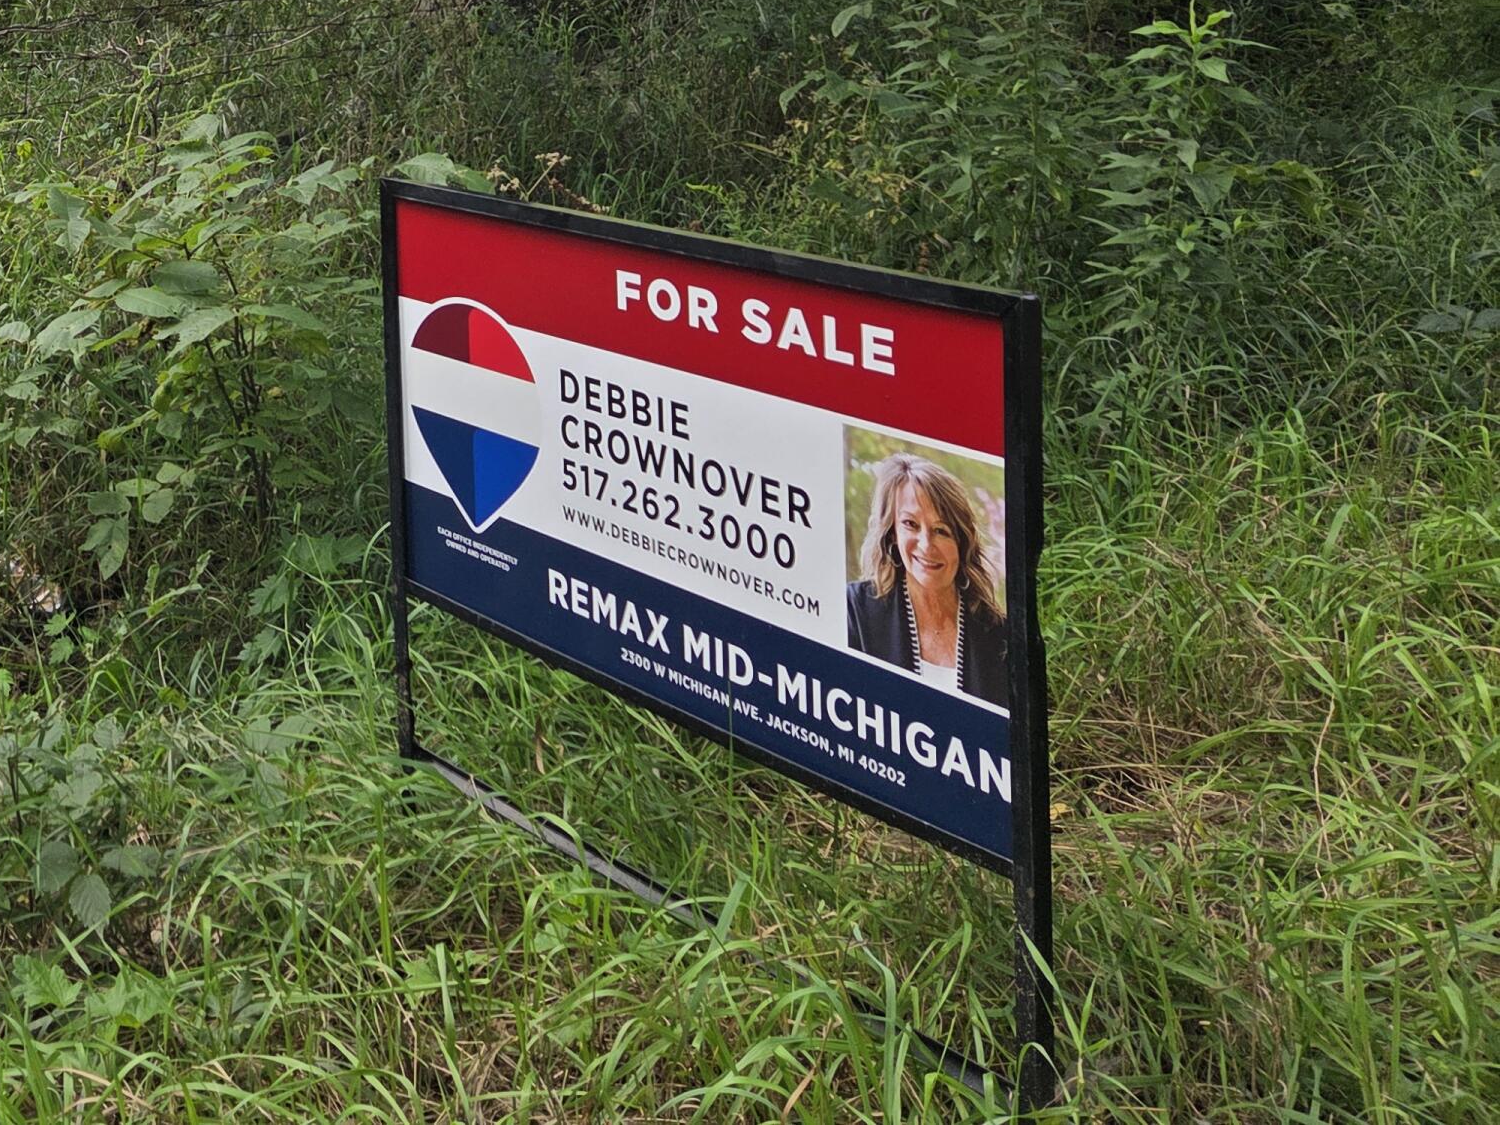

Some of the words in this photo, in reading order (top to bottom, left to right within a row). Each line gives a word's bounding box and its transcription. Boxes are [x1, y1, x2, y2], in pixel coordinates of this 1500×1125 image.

[616, 269, 719, 333] FOR
[741, 298, 895, 376] SALE
[560, 368, 690, 441] DEBBIE
[561, 415, 812, 529] CROWNOVER
[562, 458, 796, 569] 517.262.3000
[562, 504, 821, 617] WWW.DEBBIECROWNOVER.COM
[548, 568, 671, 655] REMAX
[683, 622, 1012, 804] MID-MICHIGAN
[620, 647, 651, 672] 2300
[653, 661, 666, 678] W
[668, 668, 730, 708] MICHIGAN
[766, 713, 834, 757] JACKSON,
[837, 743, 855, 764] MI
[858, 754, 906, 787] 40202
